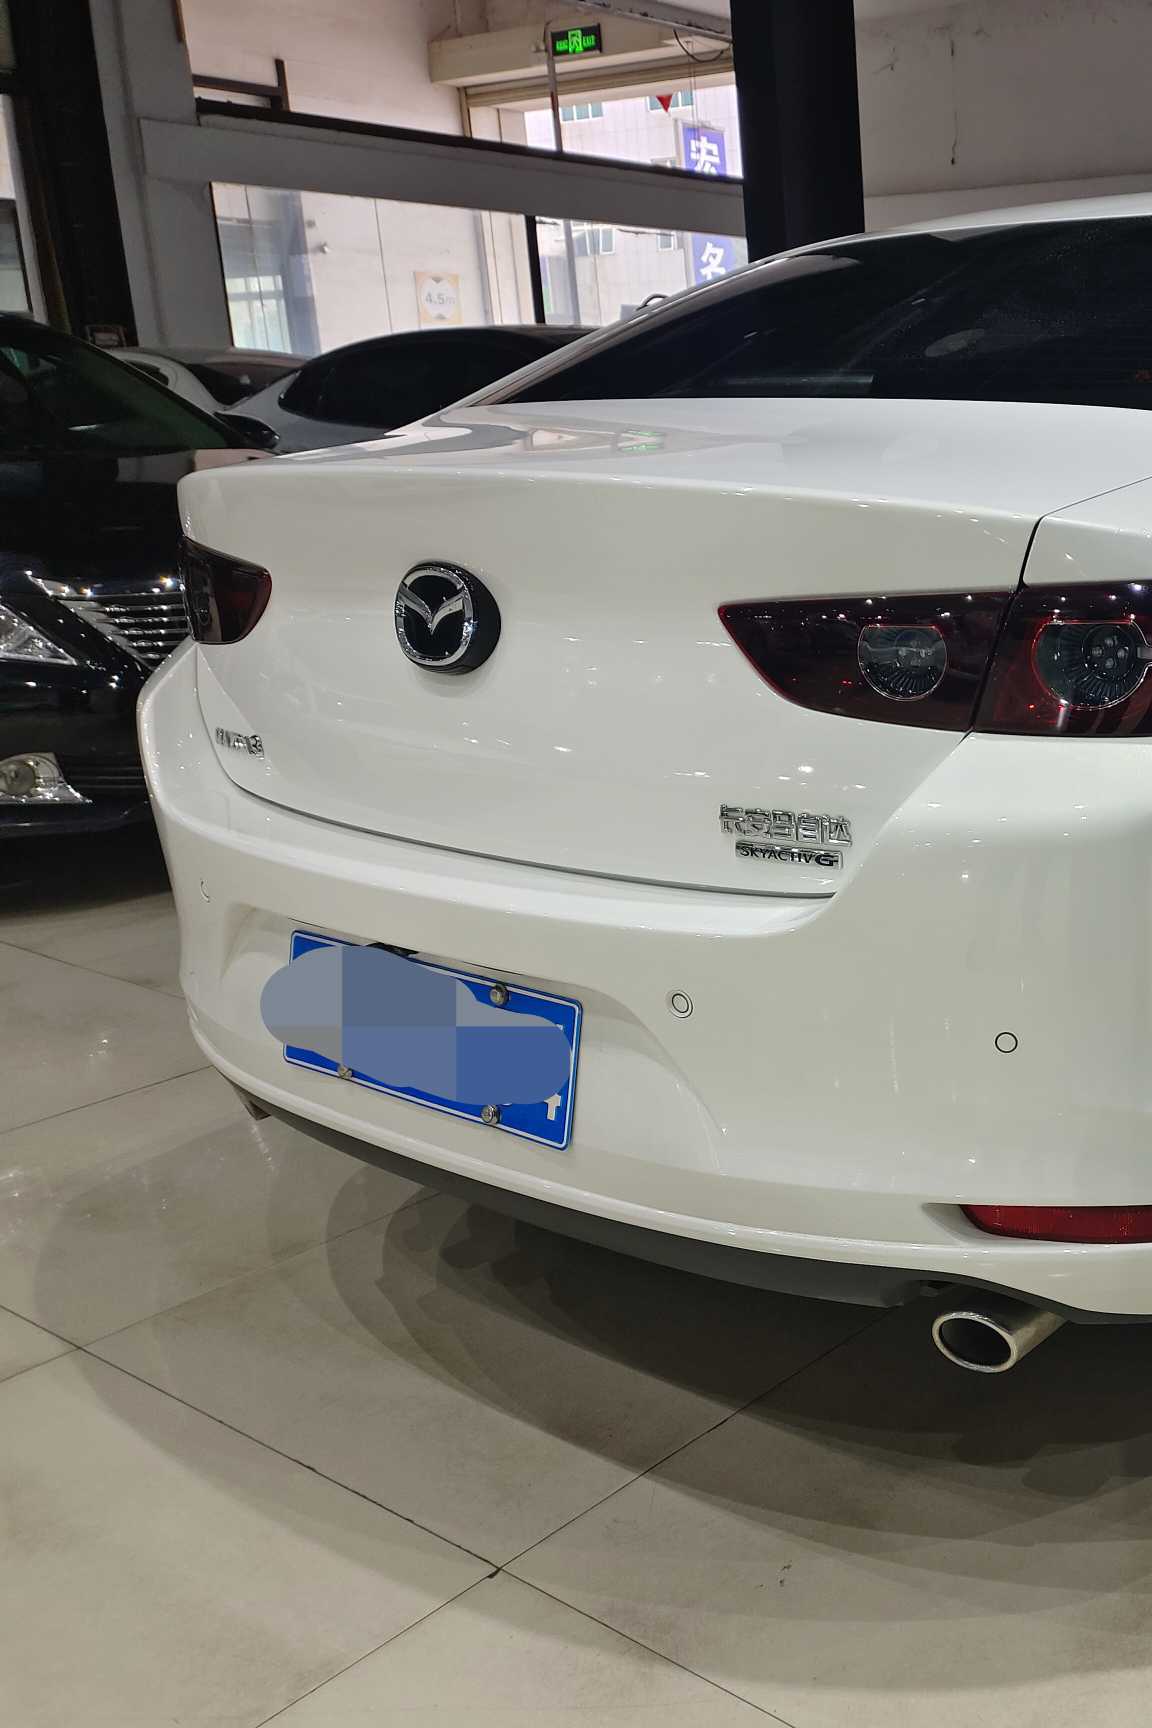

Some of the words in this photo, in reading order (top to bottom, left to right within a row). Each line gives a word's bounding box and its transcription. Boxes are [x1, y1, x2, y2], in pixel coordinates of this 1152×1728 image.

[719, 803, 852, 847] 长安马自达
